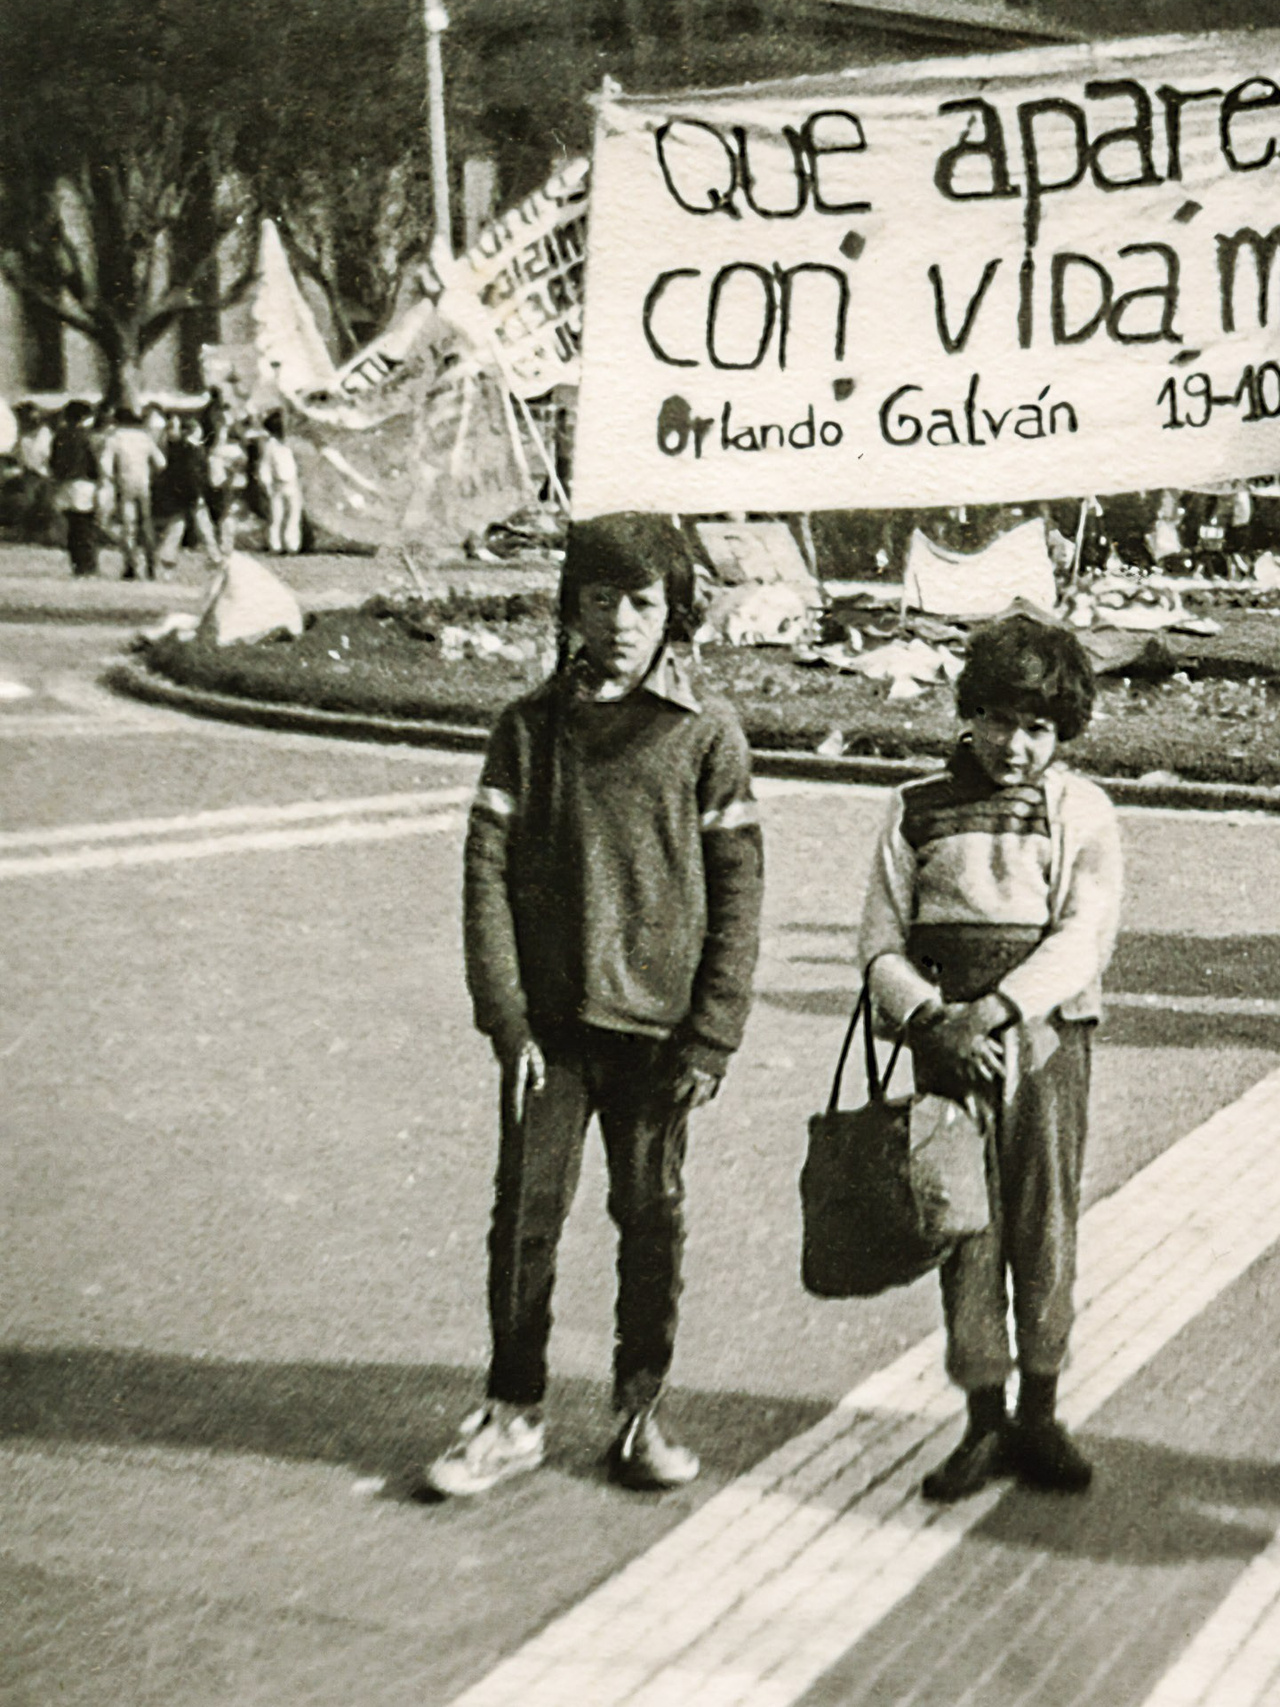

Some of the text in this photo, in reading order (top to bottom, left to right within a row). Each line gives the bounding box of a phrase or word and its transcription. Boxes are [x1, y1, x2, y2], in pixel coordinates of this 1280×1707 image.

[655, 109, 873, 219] Que
[642, 260, 851, 371] con
[657, 395, 843, 460] Orlando
[878, 373, 1078, 447] Galván
